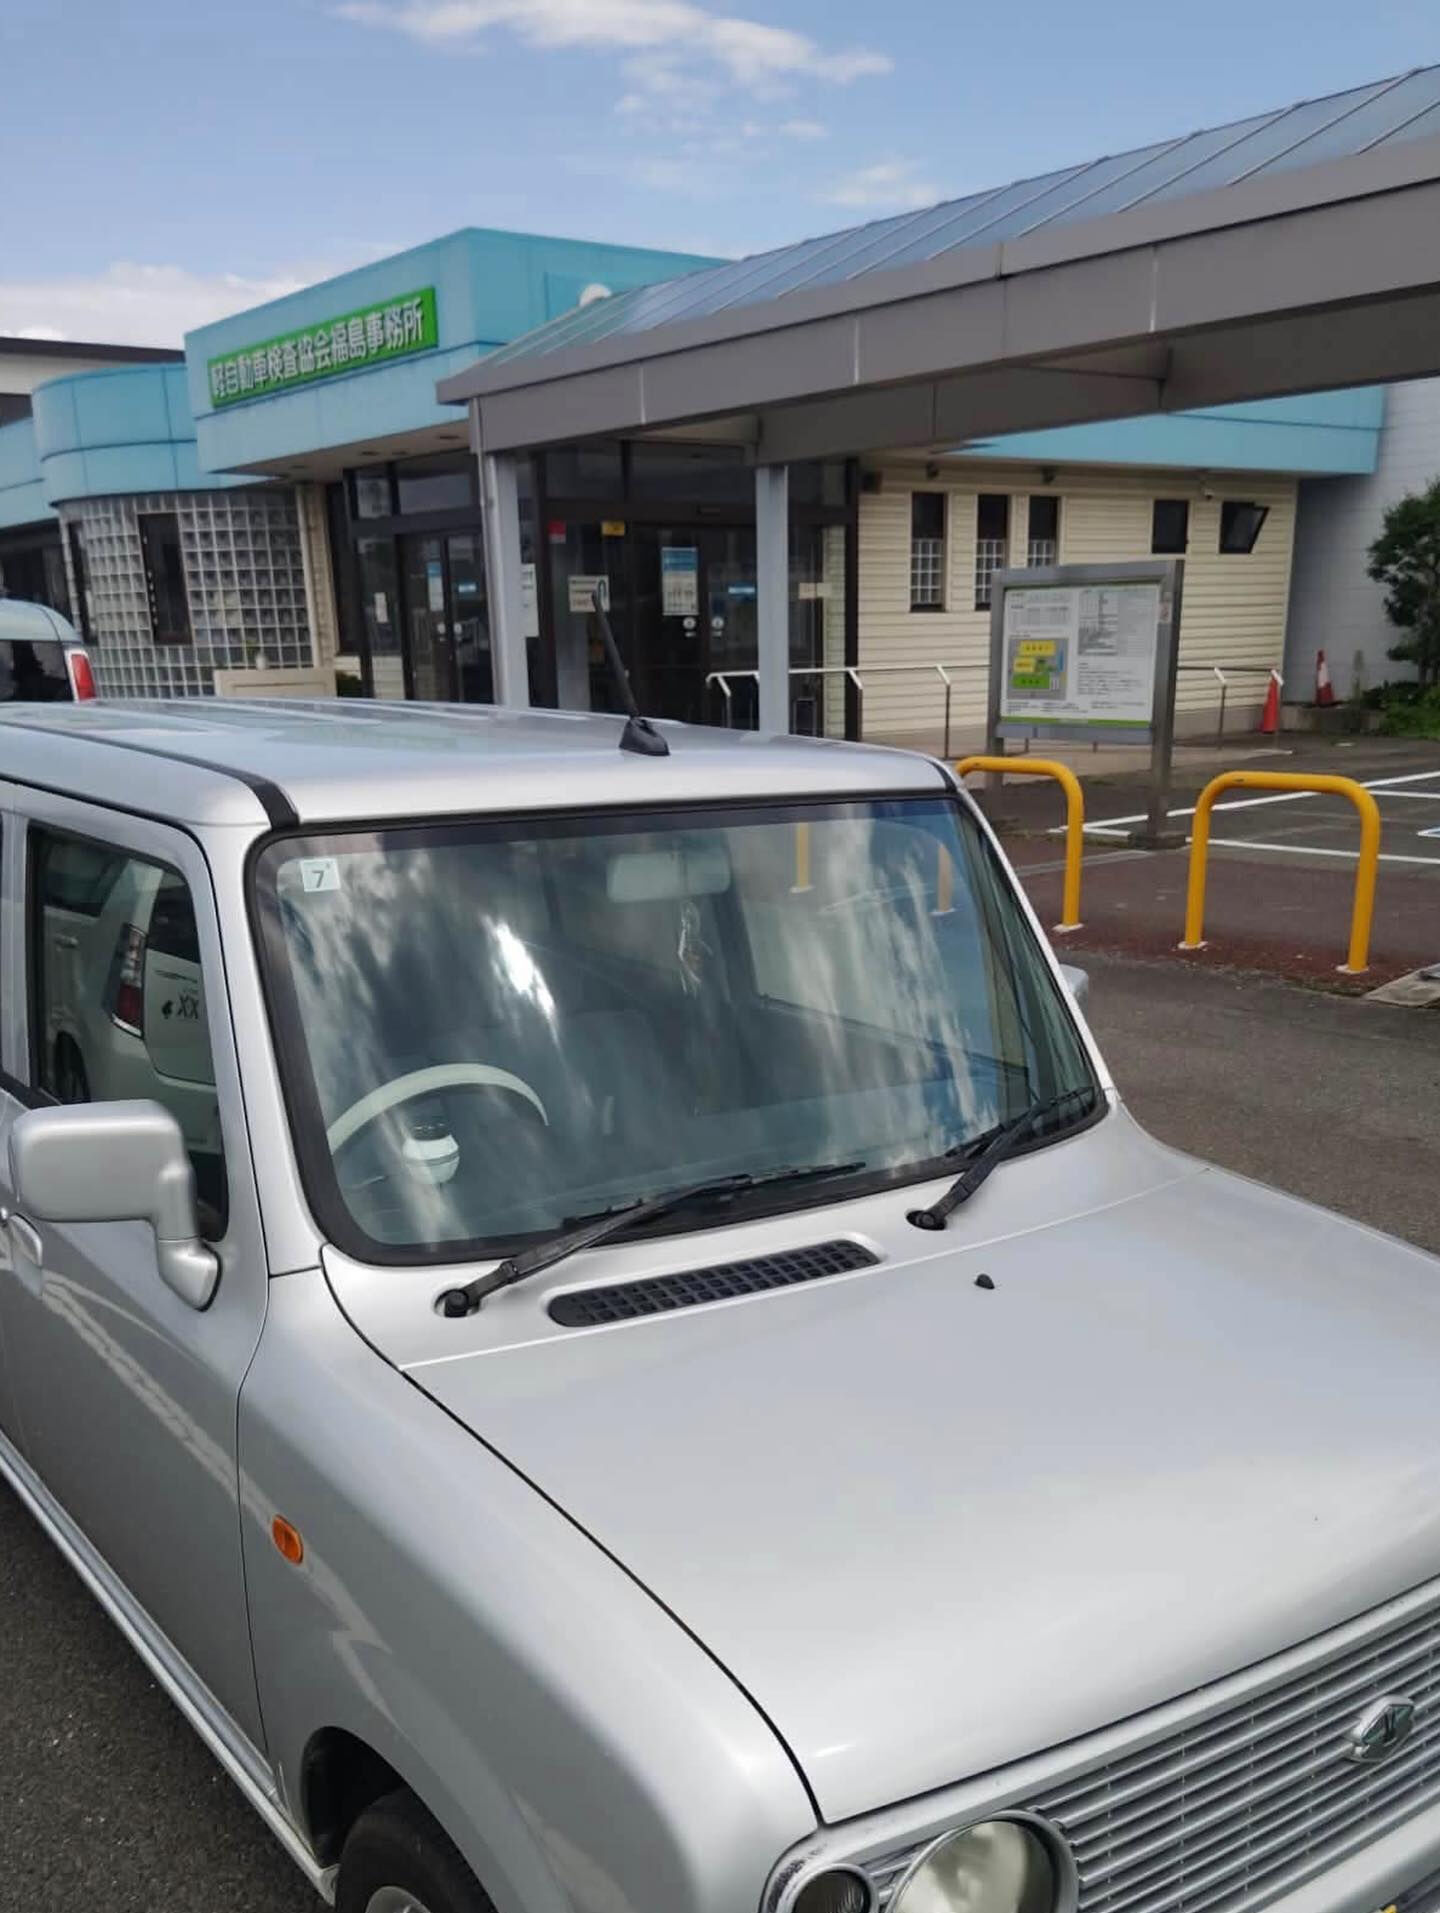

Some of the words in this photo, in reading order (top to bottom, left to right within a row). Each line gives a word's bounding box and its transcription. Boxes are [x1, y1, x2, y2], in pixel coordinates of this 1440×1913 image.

[211, 297, 424, 398] 軽自動車検査協会福島事務所
[312, 870, 325, 888] 7
